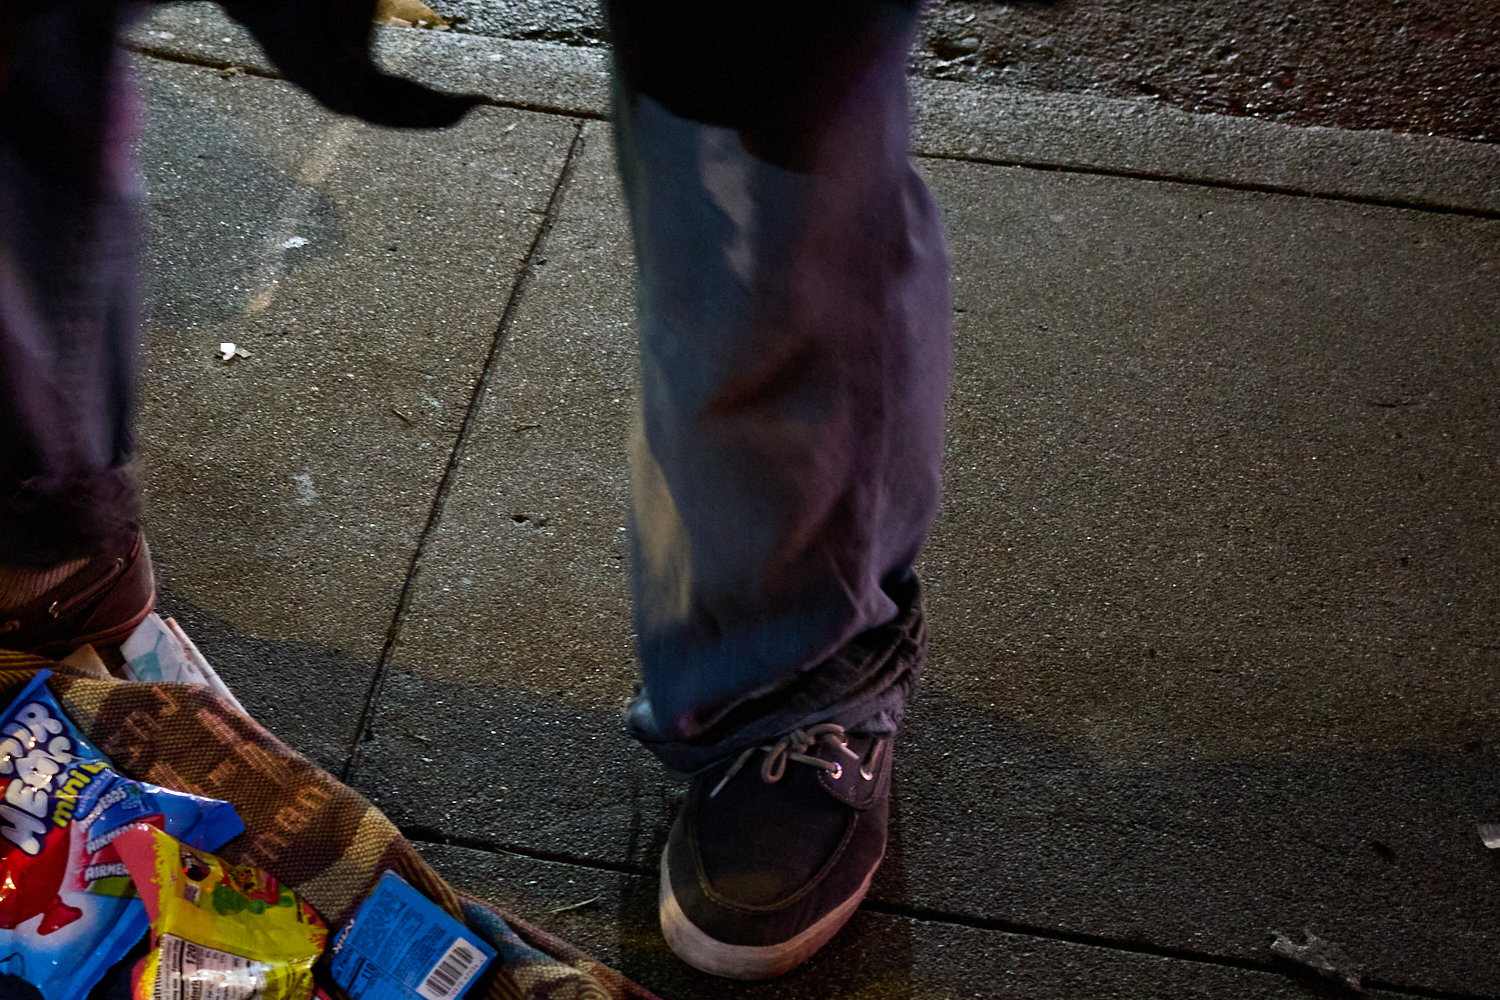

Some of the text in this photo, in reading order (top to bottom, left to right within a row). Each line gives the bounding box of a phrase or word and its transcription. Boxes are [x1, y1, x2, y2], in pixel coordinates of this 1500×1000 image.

[52, 769, 90, 828] mini
[84, 861, 130, 880] AIRHE
[185, 942, 196, 964] 120
